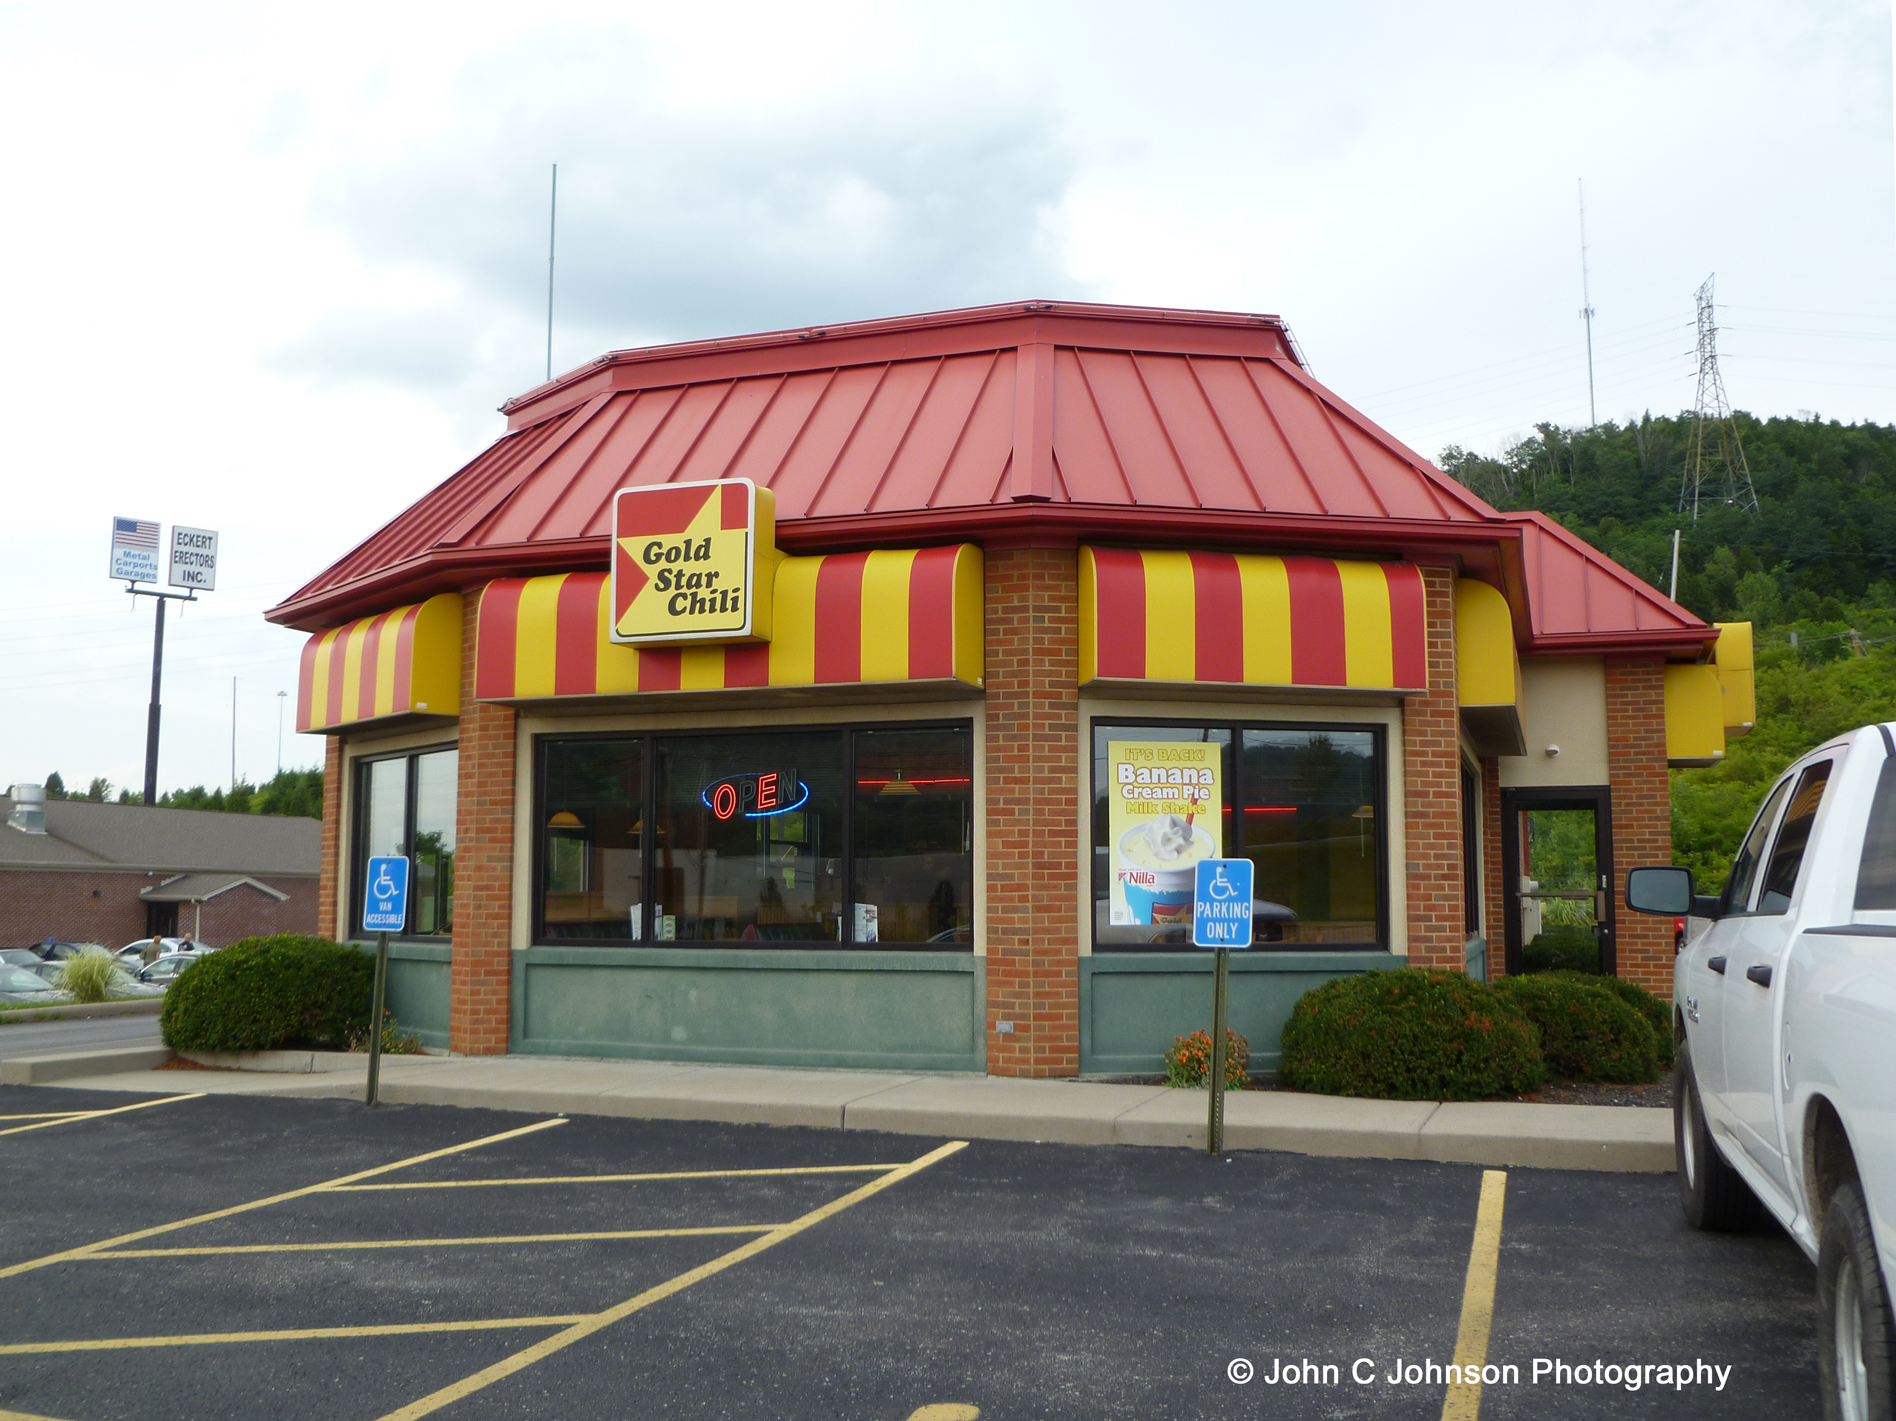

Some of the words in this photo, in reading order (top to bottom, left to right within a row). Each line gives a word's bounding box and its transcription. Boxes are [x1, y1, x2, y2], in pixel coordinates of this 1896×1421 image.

[177, 532, 213, 550] ECKERT
[123, 550, 150, 561] Metal
[643, 537, 711, 565] Gold
[115, 558, 158, 571] Carports
[174, 550, 215, 569] ERECTORS
[116, 567, 157, 580] Garages
[182, 570, 206, 583] INC.
[654, 568, 720, 592] Star
[668, 587, 741, 616] Chili
[1125, 748, 1153, 761] IT'S
[1158, 749, 1205, 761] BACK!
[1117, 763, 1214, 785] Banana
[713, 769, 797, 820] OPEN
[1121, 784, 1179, 799] Cream
[1182, 784, 1210, 799] Pie
[1126, 801, 1159, 814] Milk
[1162, 802, 1206, 814] Shake
[1128, 872, 1155, 884] Nilla
[379, 902, 392, 911] VAN
[1197, 902, 1249, 919] PARKING
[366, 913, 402, 924] ACCESSIBLE
[1207, 922, 1238, 939] ONLY
